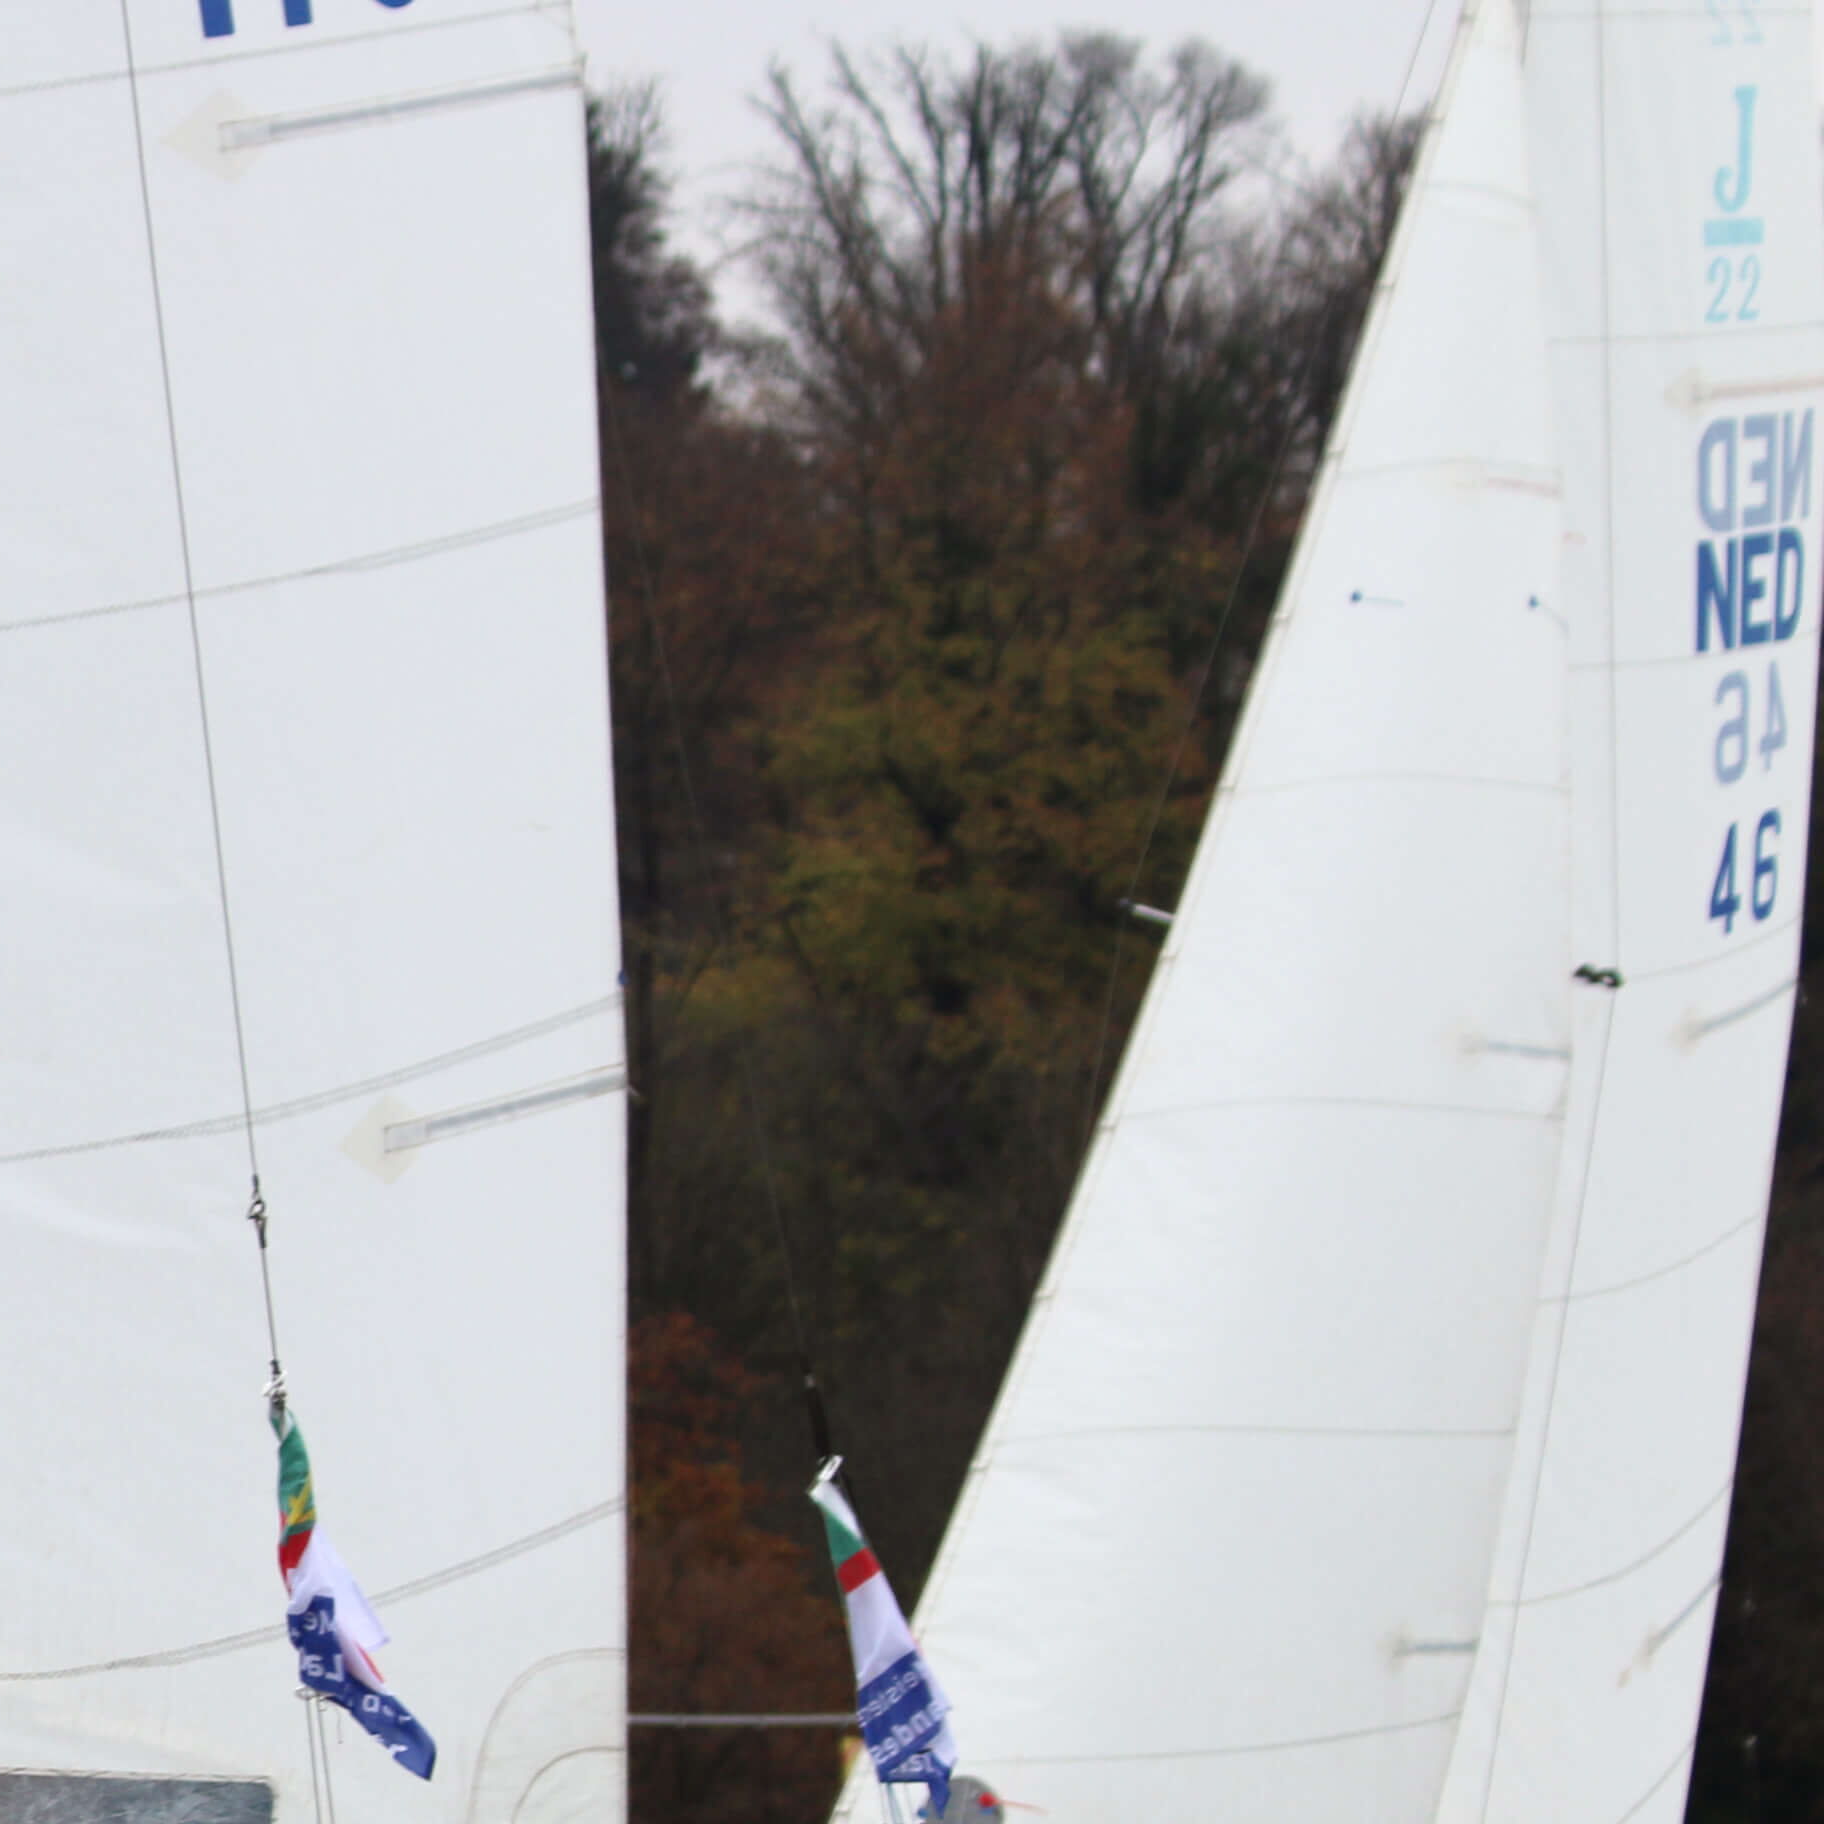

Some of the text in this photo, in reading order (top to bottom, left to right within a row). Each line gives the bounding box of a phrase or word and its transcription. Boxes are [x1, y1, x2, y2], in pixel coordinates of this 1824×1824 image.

[1703, 254, 1762, 323] 22
[1696, 528, 1805, 652] NED
[1709, 807, 1781, 934] 46
